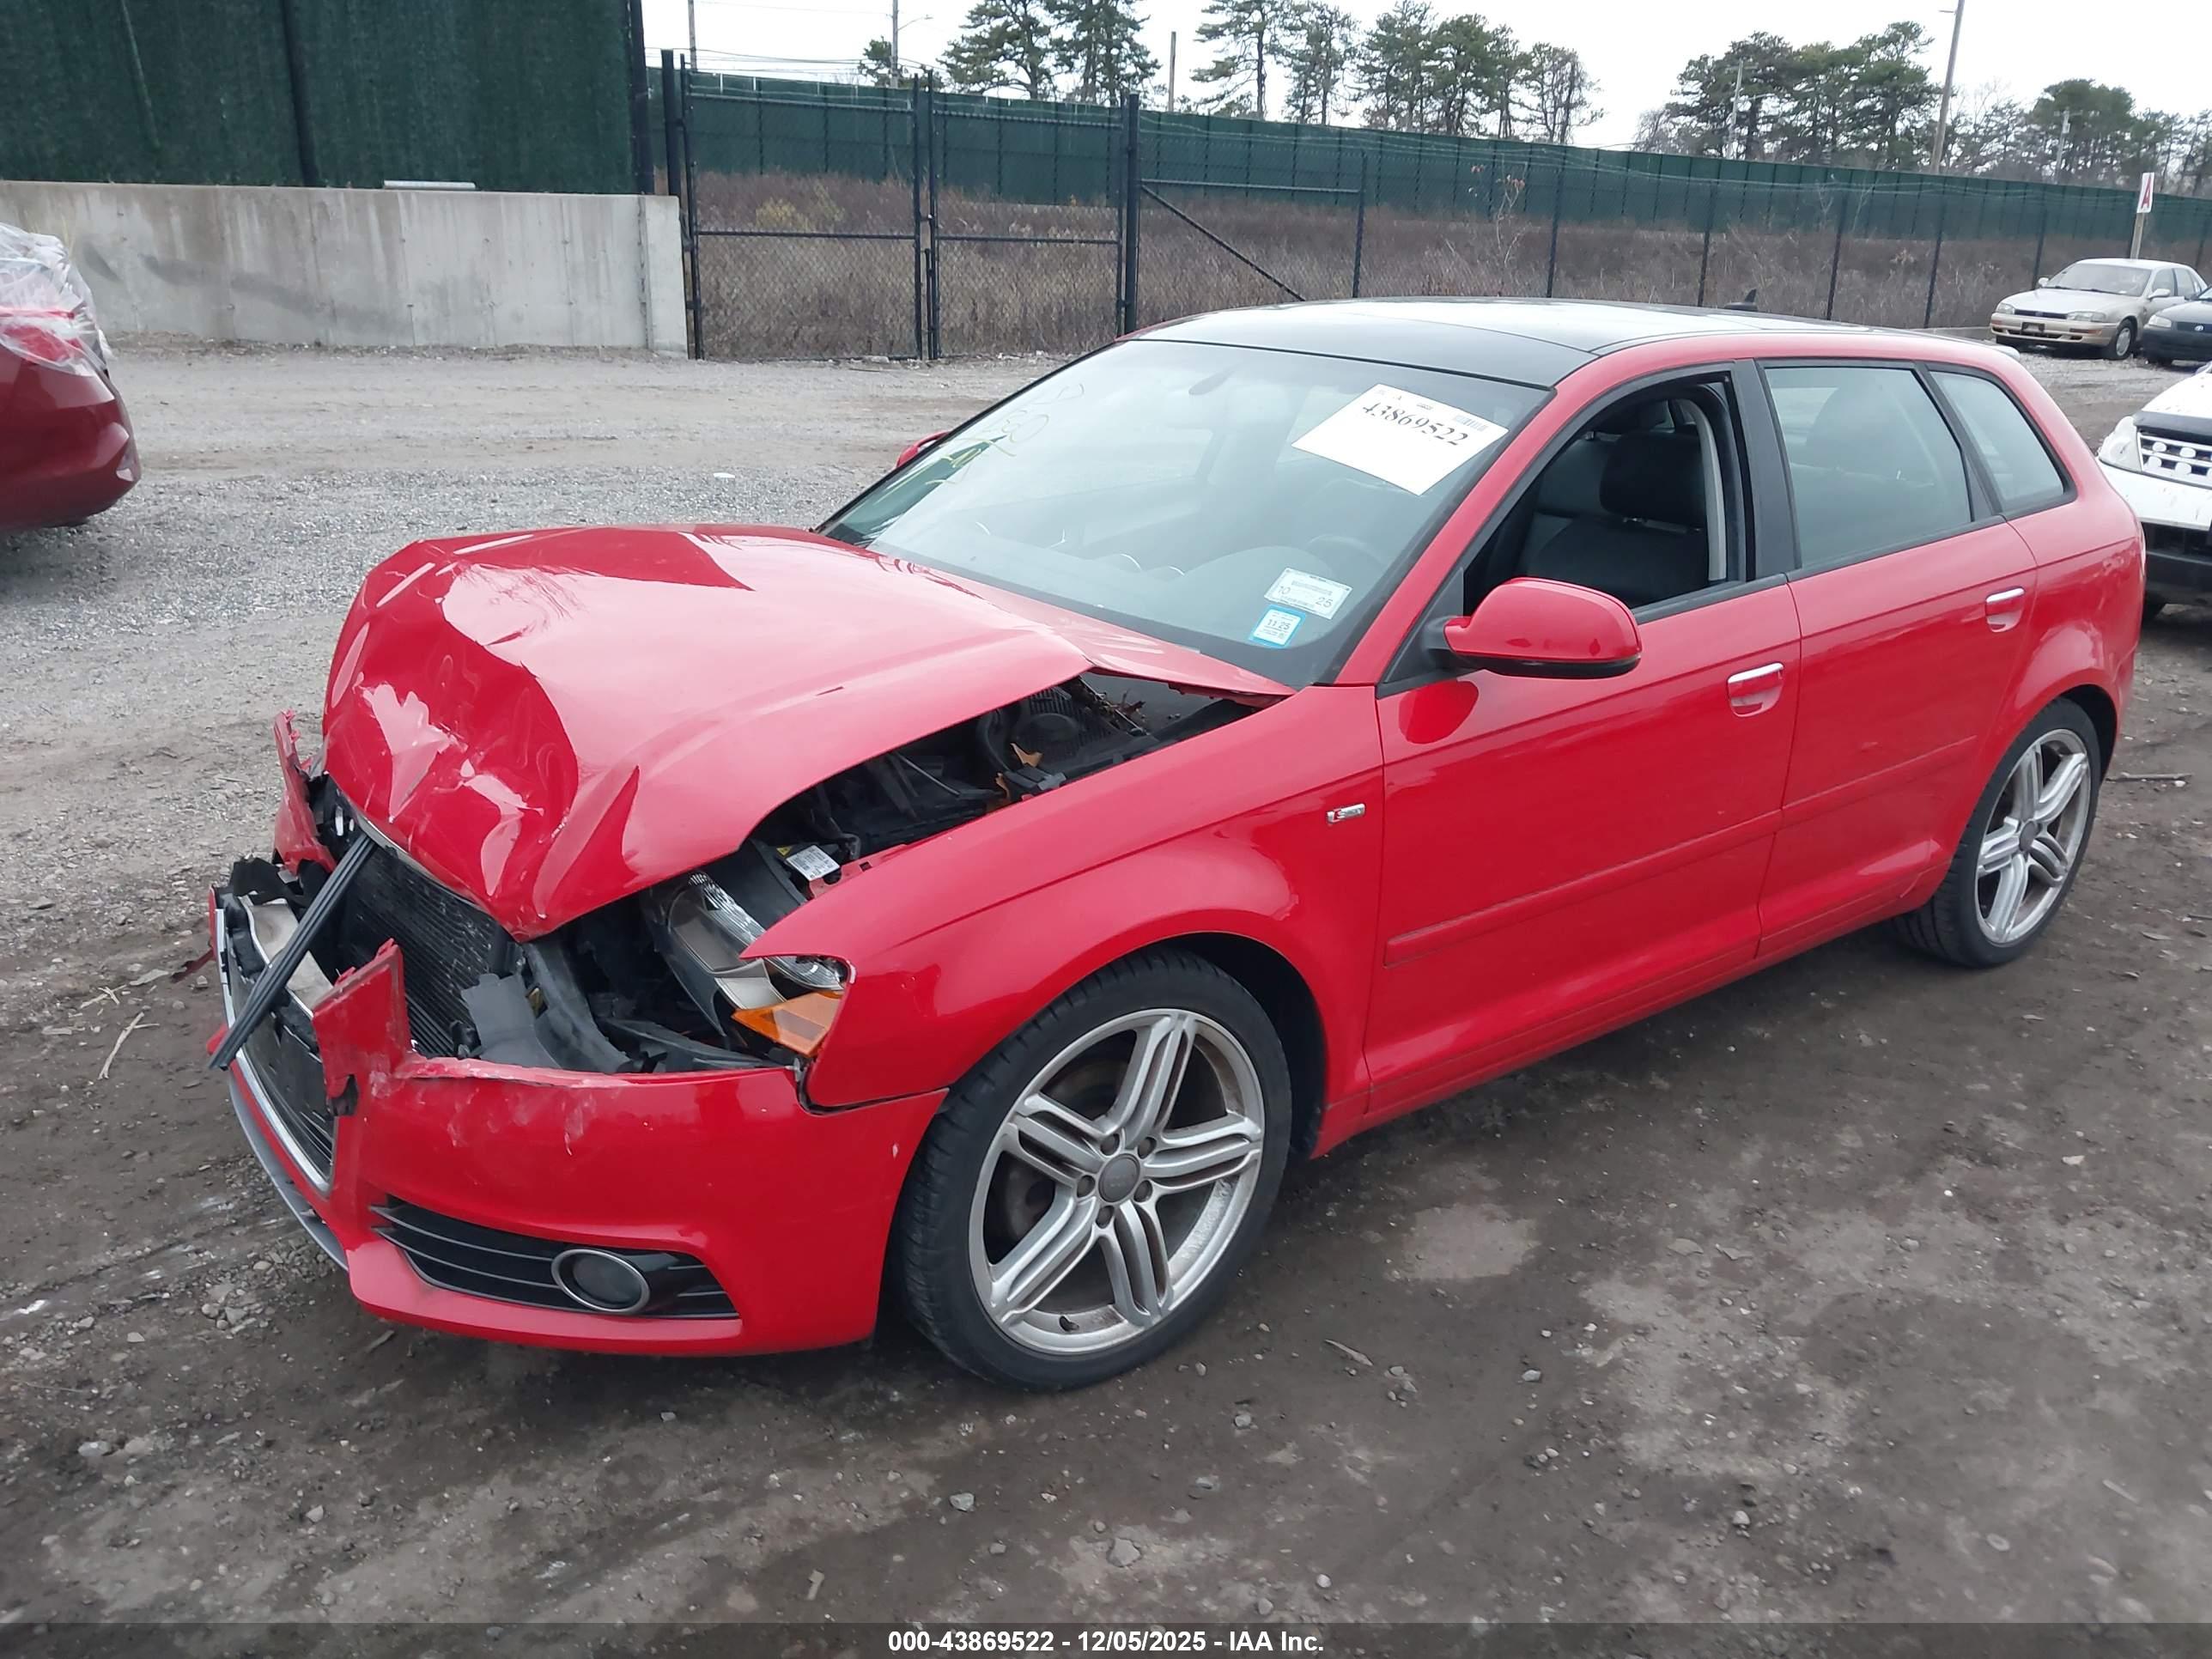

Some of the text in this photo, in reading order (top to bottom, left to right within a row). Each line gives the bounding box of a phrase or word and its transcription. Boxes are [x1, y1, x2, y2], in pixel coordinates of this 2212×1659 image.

[2141, 173, 2151, 209] A
[1362, 402, 1468, 446] 43869522
[1316, 596, 1334, 608] 25
